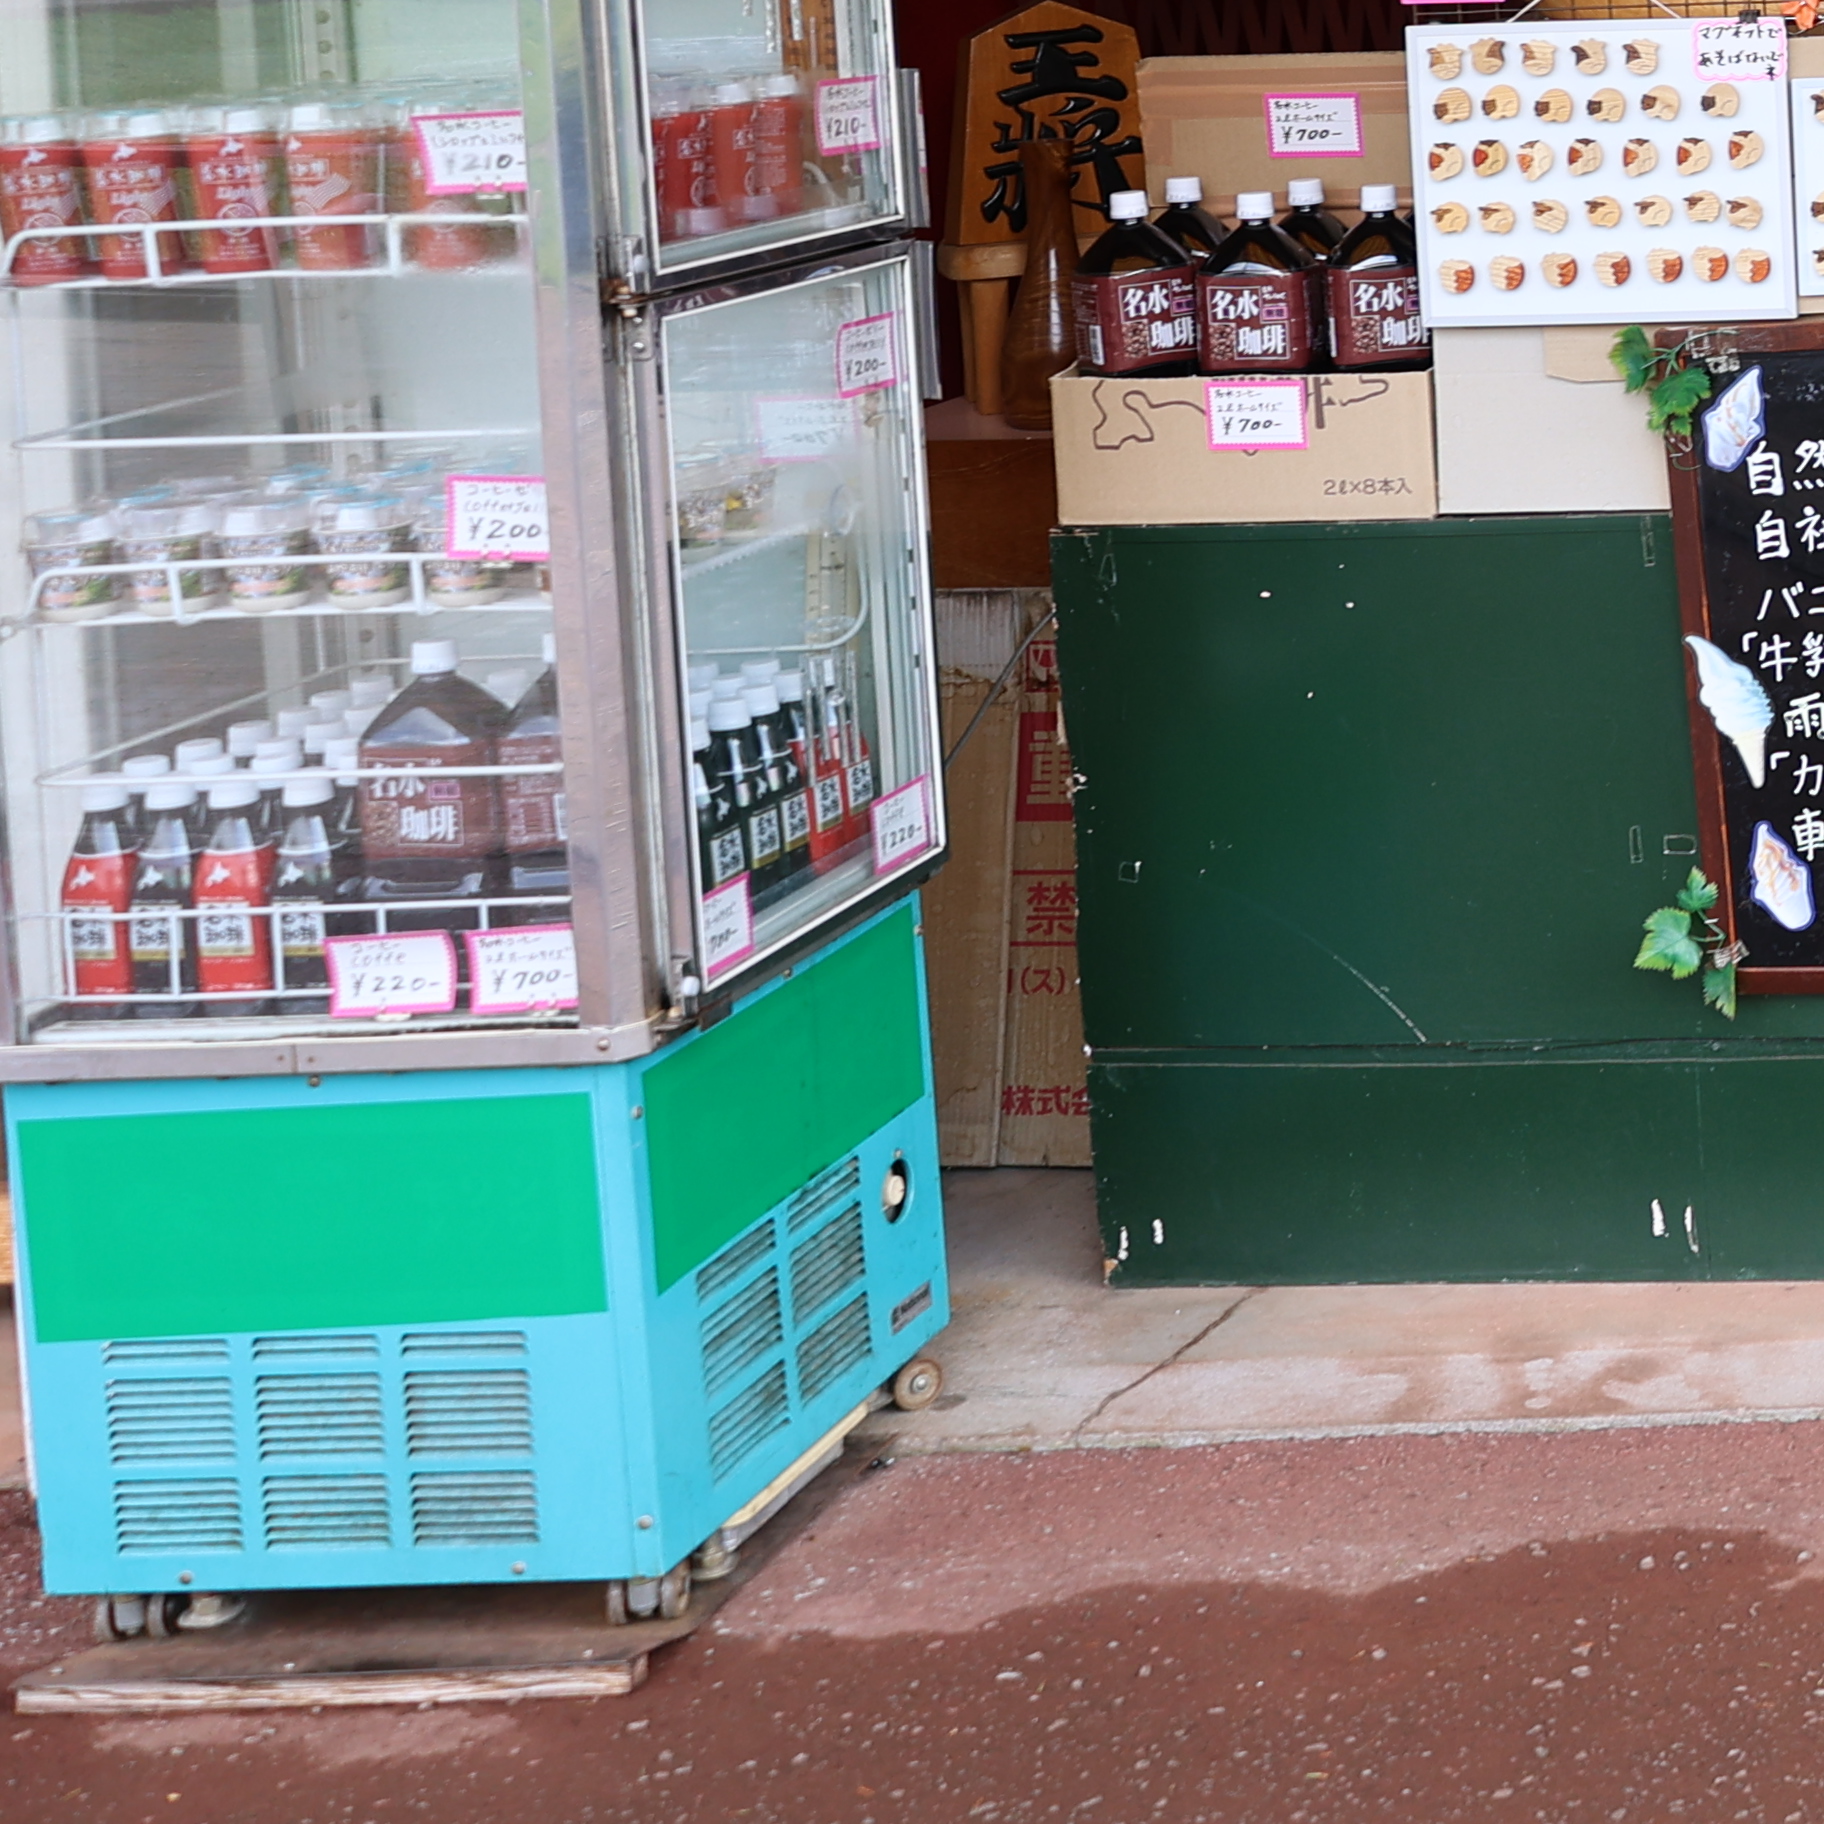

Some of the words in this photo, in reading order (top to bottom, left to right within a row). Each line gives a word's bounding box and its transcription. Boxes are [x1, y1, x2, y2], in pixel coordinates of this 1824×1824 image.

[1123, 282, 1171, 319] 名水
[1211, 289, 1261, 321] 名水
[1353, 281, 1403, 315] 名水
[1150, 316, 1199, 349] 珈琲
[1236, 324, 1288, 356] 珈琲
[1382, 314, 1430, 348] 珈琲
